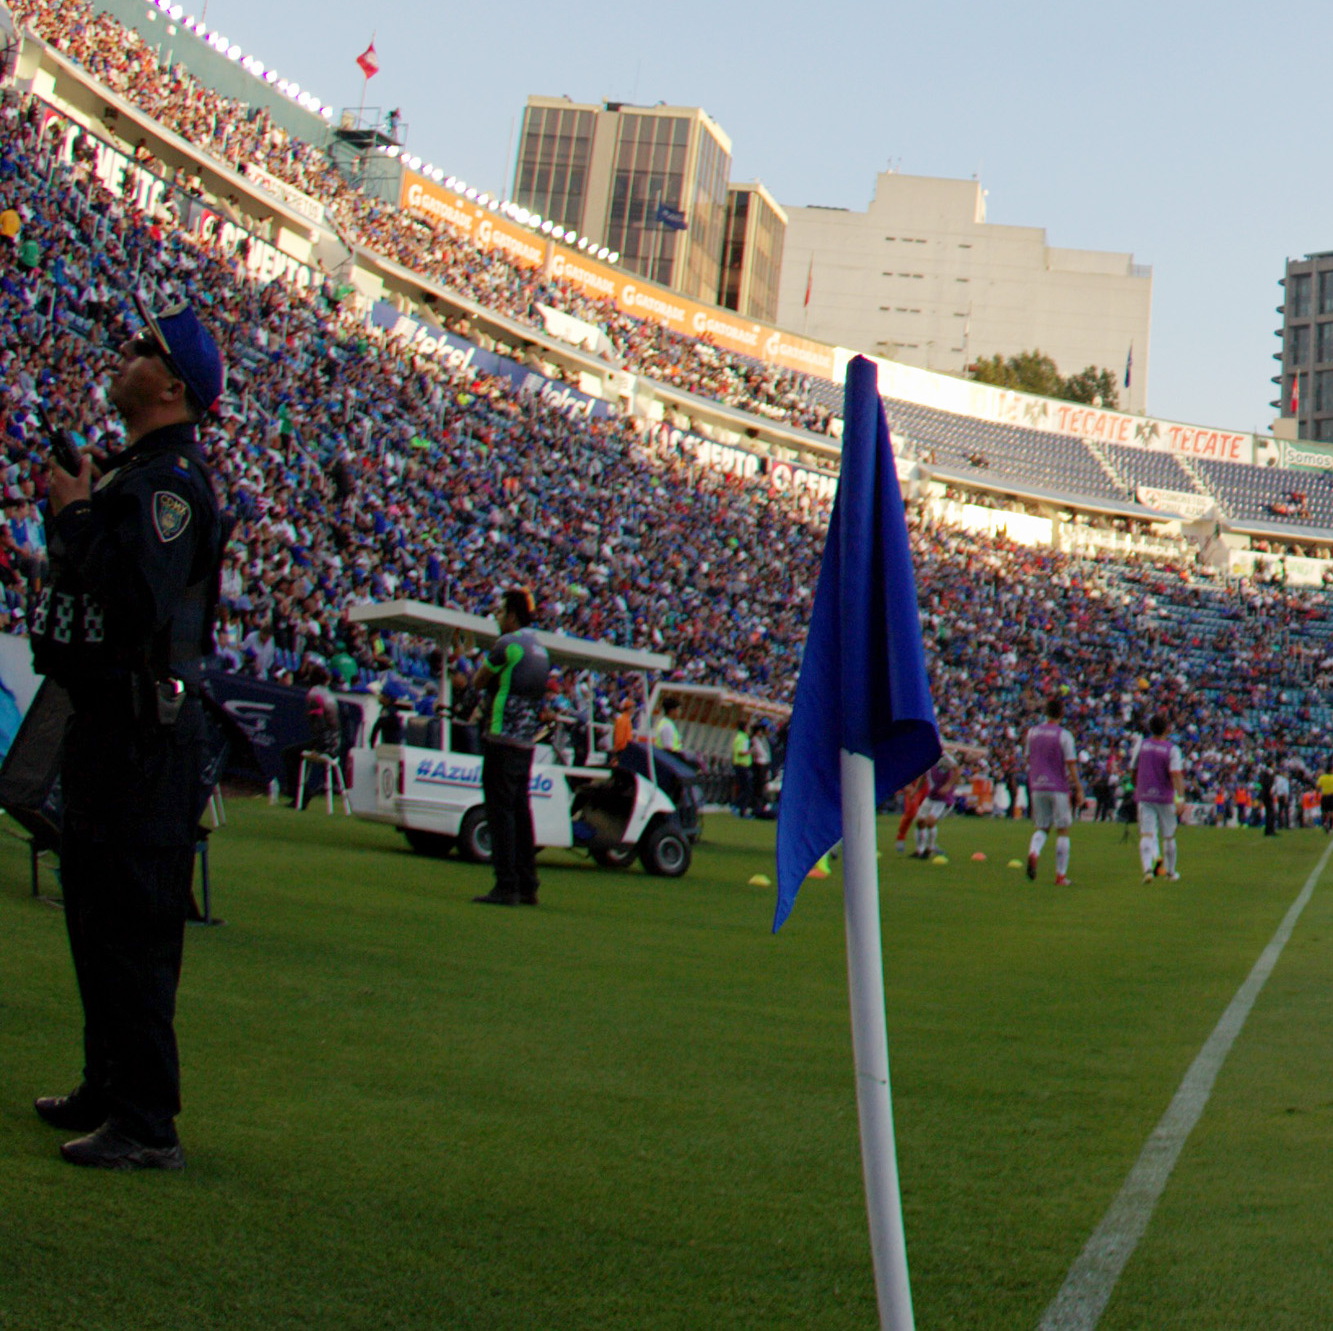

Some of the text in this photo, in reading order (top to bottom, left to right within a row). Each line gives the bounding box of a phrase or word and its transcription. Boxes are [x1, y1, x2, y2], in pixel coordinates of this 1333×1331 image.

[422, 193, 473, 231] GATORADE
[491, 226, 545, 266] GATORADE
[565, 261, 616, 296] GATORADE
[635, 291, 686, 322] GATORADE
[705, 318, 758, 347] GATORADE
[777, 342, 833, 367] GATORADE
[1057, 405, 1134, 442] TECATE
[1168, 425, 1246, 460] TECATE
[1286, 447, 1333, 468] Somos
[160, 494, 188, 516] CDMX
